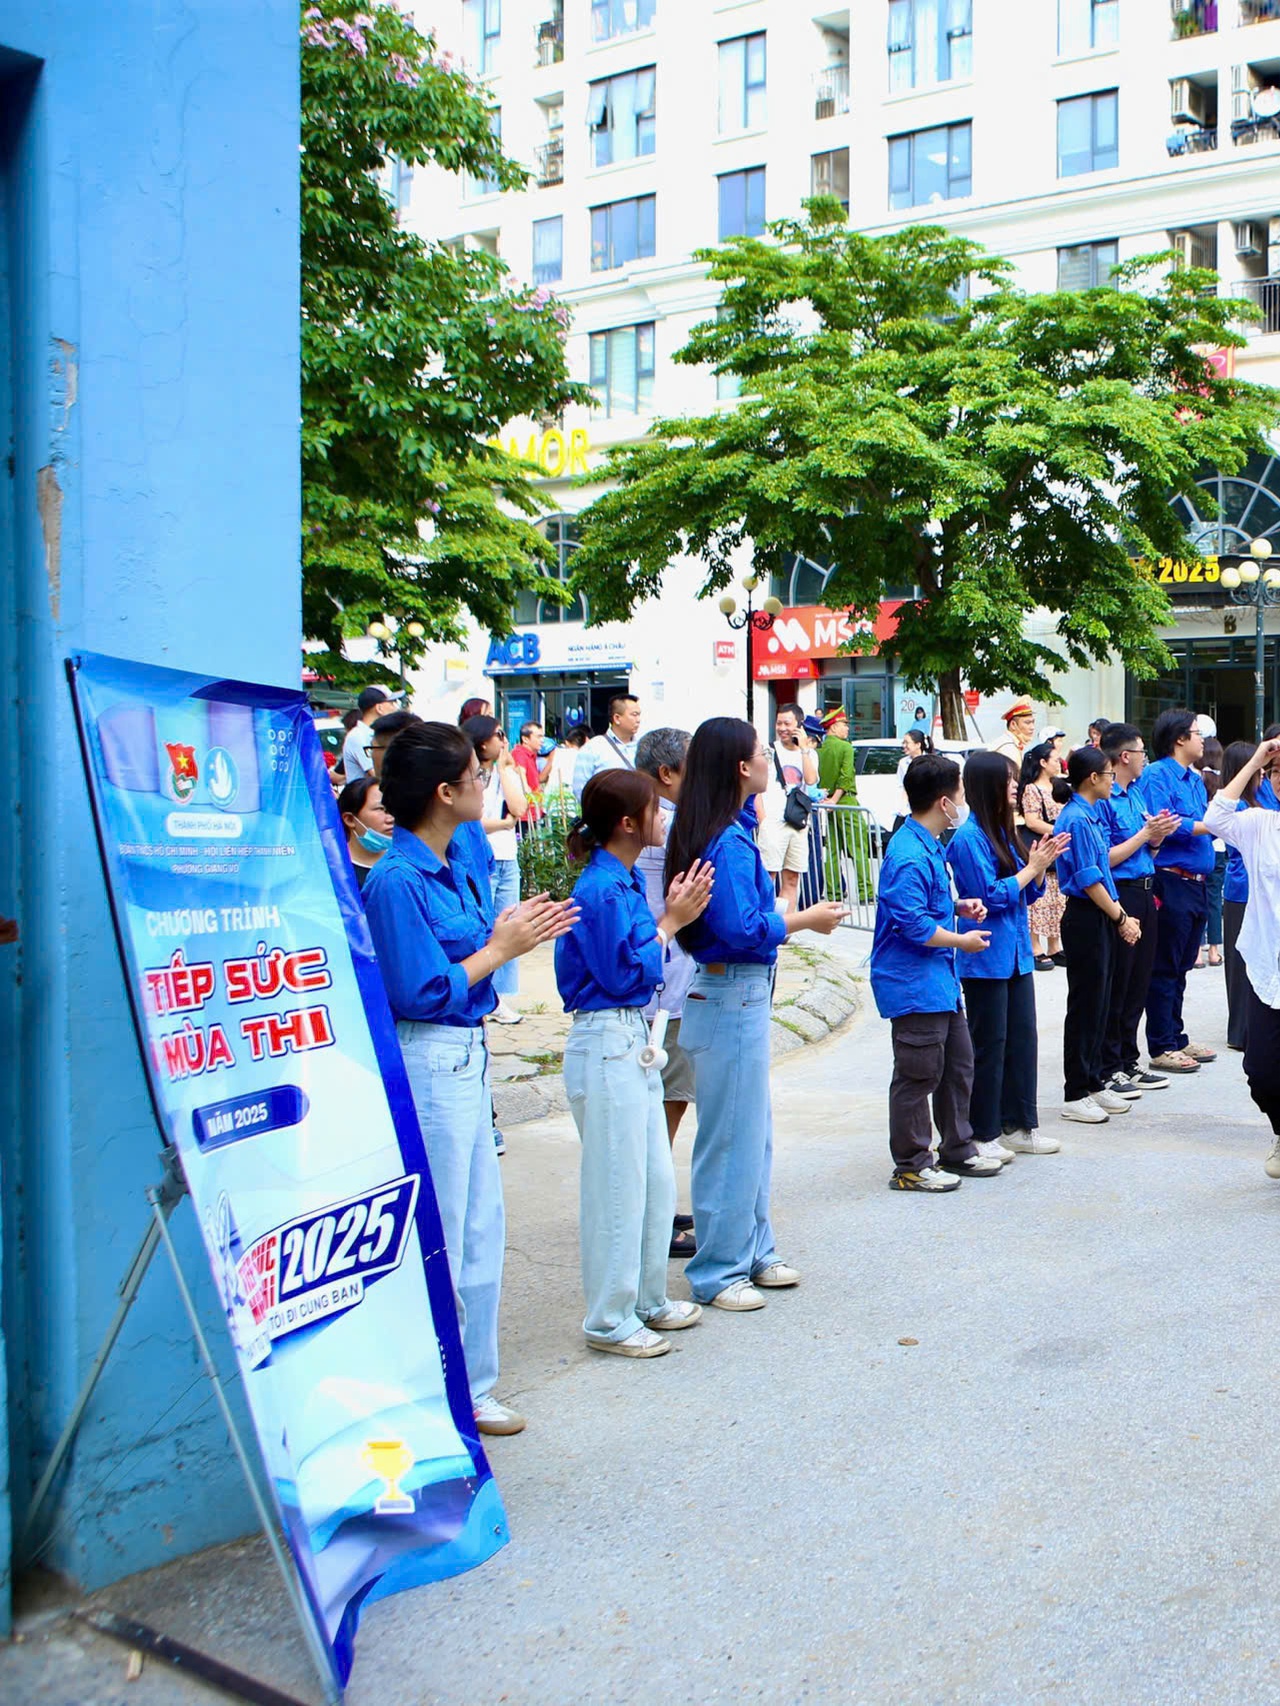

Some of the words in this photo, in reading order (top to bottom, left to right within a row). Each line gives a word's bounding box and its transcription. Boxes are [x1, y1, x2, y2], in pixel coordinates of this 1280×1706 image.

[487, 428, 591, 478] MOR
[1158, 555, 1220, 583] 2025
[486, 633, 540, 665] ACB
[718, 646, 735, 654] ATM
[145, 908, 218, 936] CHƯƠNG
[221, 902, 281, 931] TRÌNH
[145, 950, 214, 1015] TIẾP
[225, 944, 330, 1003] SỨC
[162, 1019, 234, 1080] MÙA
[242, 1006, 334, 1060] THI
[207, 1111, 234, 1138] NĂM
[234, 1102, 268, 1129] 2025
[281, 1188, 401, 1295] 2025
